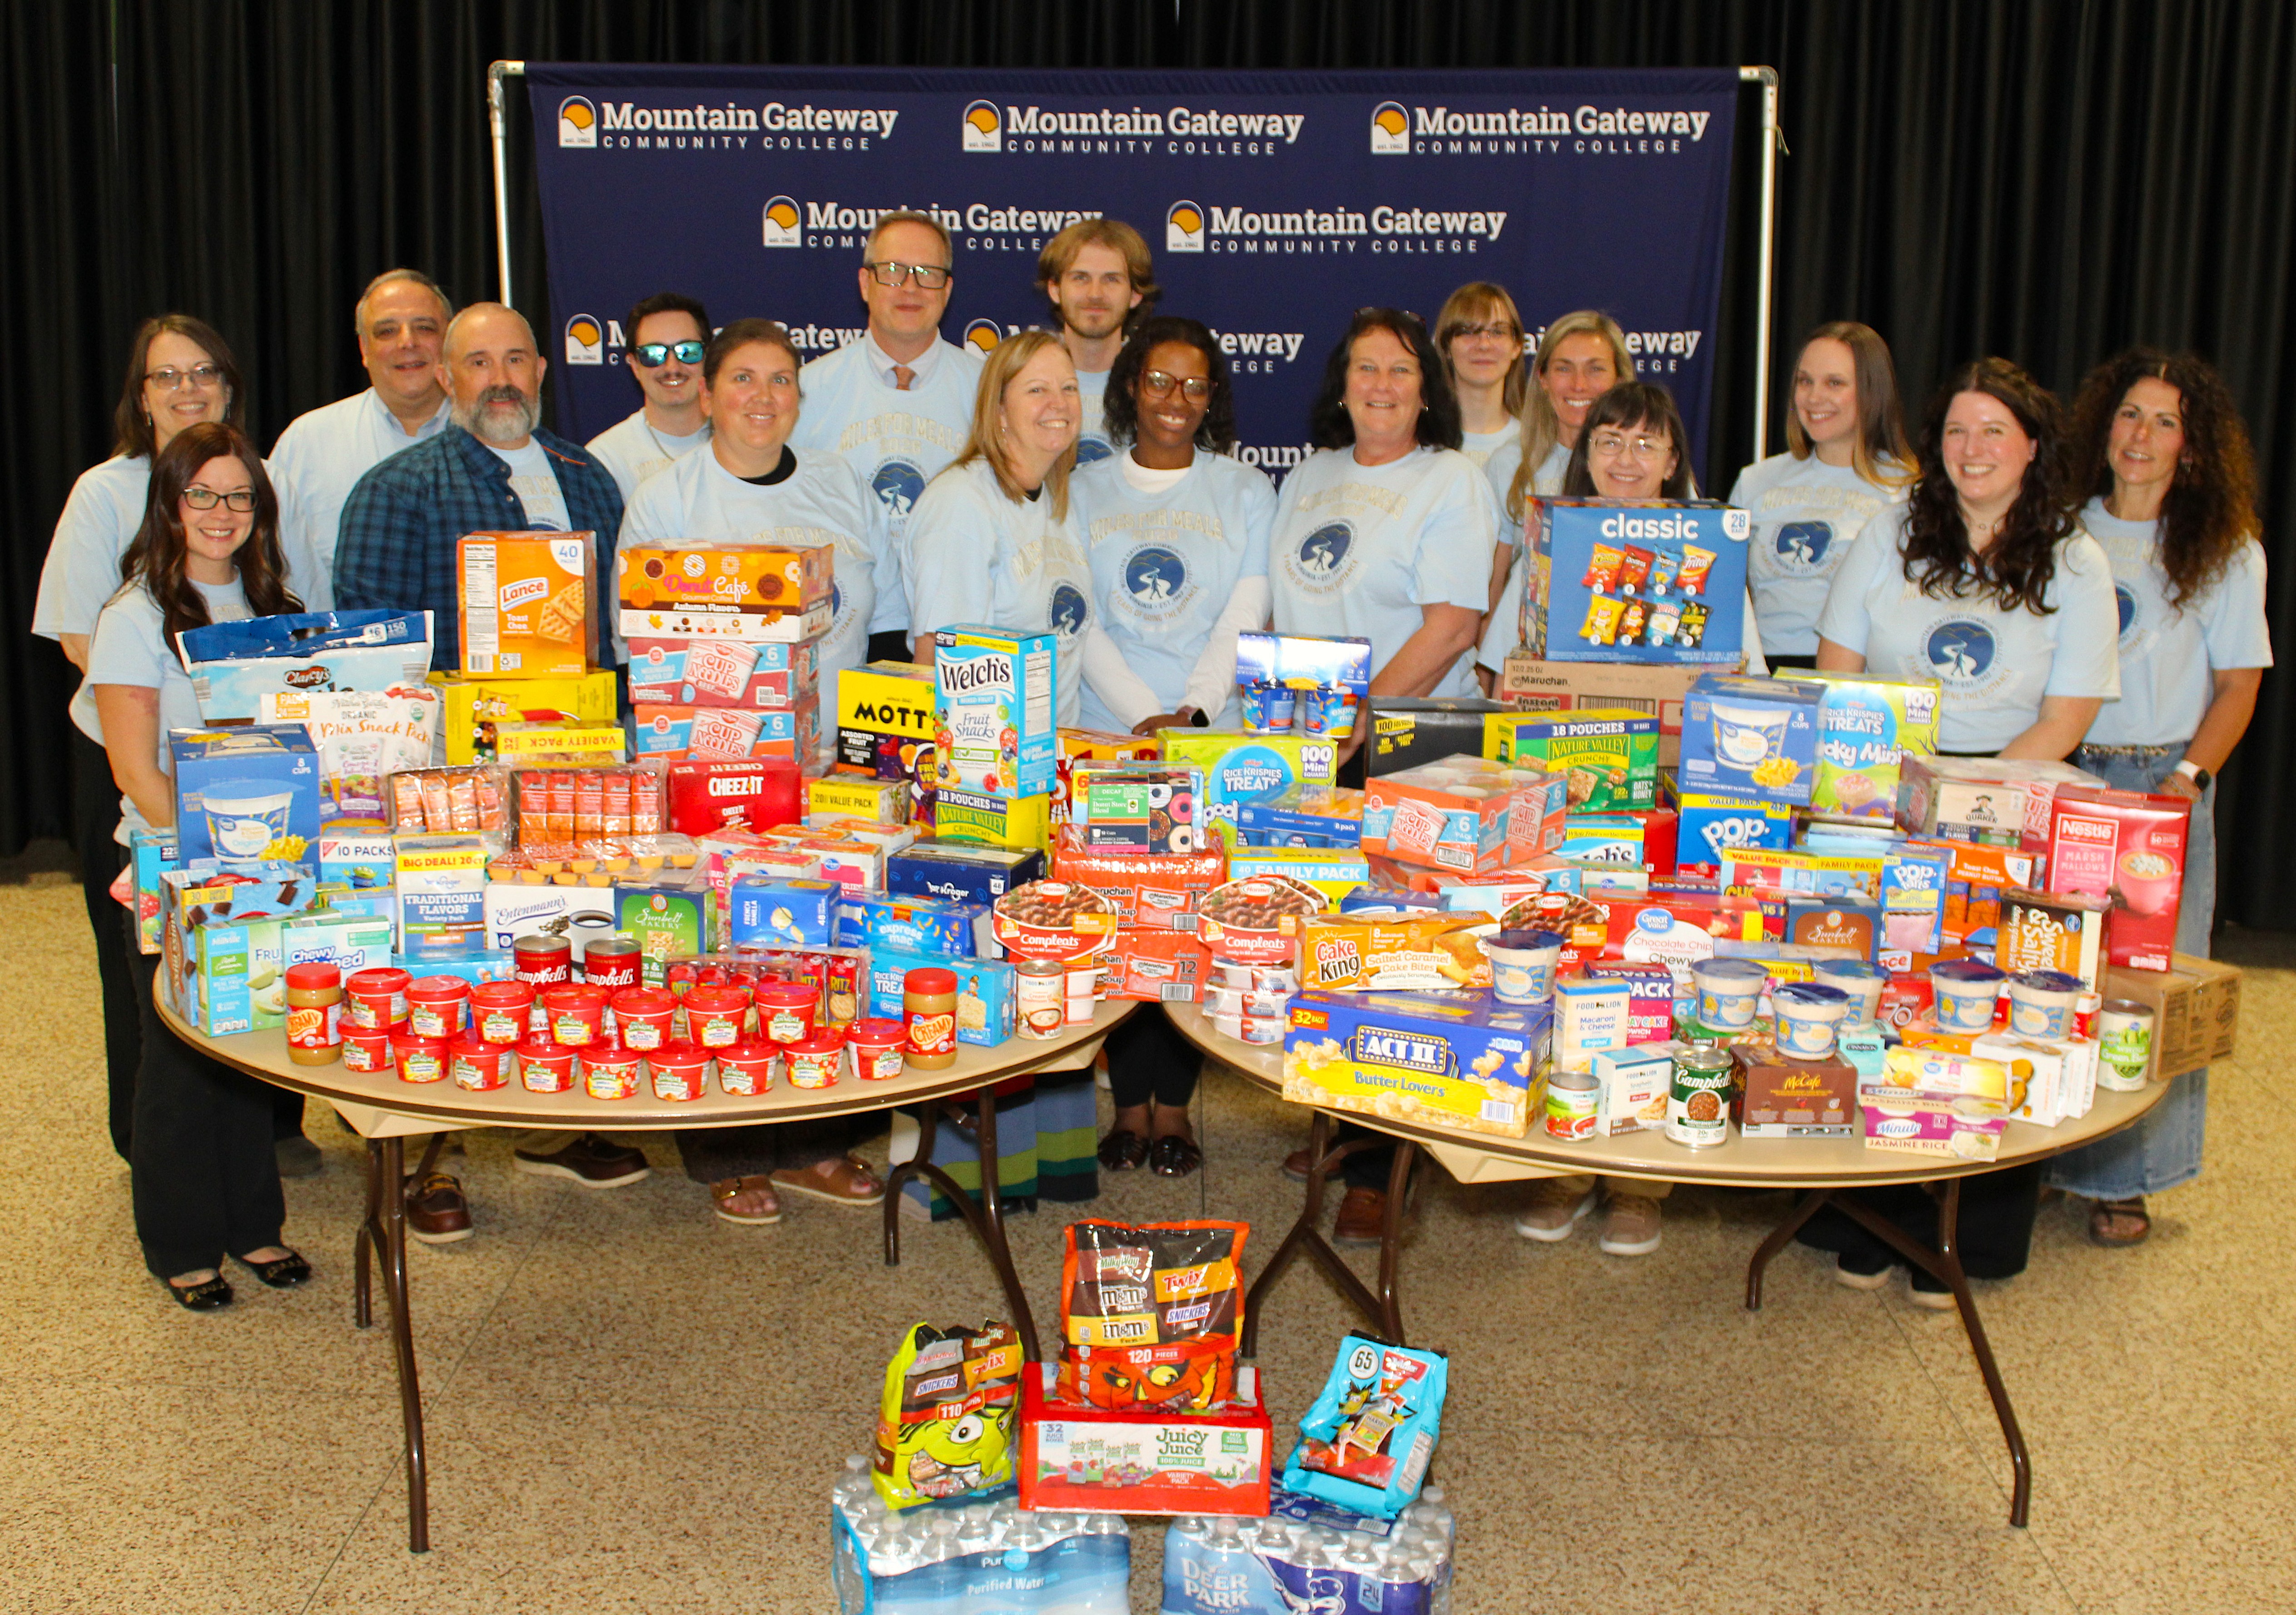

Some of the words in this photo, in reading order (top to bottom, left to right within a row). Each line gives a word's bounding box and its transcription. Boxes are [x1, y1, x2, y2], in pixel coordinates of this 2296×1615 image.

[602, 102, 759, 131] Mountain
[763, 103, 899, 138] Gateway
[1008, 106, 1164, 135] Mountain
[1168, 107, 1304, 142] Gateway
[1415, 107, 1571, 135] Mountain
[1575, 106, 1710, 140] Gateway
[604, 136, 748, 149] COMMUNITY
[764, 137, 870, 150] COLLEGE
[1009, 141, 1152, 154] COMMUNITY
[1169, 142, 1275, 155] COLLEGE
[1416, 140, 1559, 153] COMMUNITY
[1575, 140, 1681, 153] COLLEGE
[1210, 206, 1368, 235] Mountain
[1372, 206, 1506, 241] Gateway
[1211, 240, 1357, 253] COMMUNITY
[1372, 240, 1477, 253] COLLEGE
[1601, 513, 1699, 539] classic
[1731, 514, 1746, 528] 28
[1090, 514, 1134, 550] MILES
[1138, 509, 1167, 528] FOR
[1172, 509, 1223, 541] MEALS
[1132, 529, 1179, 540] 2026
[559, 545, 578, 558] 40
[1683, 555, 1707, 568] Fritos
[502, 580, 544, 602] Lance
[713, 576, 750, 603] Café
[673, 602, 707, 612] Autumn
[708, 603, 741, 613] Flavors
[767, 647, 778, 661] 6
[702, 654, 736, 673] CUP
[687, 662, 740, 691] NOODLES
[941, 658, 1011, 691] Welch's
[1904, 691, 1937, 708] 100
[963, 713, 991, 725] Fruit
[1847, 708, 1885, 721] KRISPIES
[1908, 708, 1931, 718] Mini
[358, 719, 400, 733] Snack
[772, 716, 784, 730] 6
[1553, 725, 1566, 736] 18
[1570, 722, 1625, 734] POUCHES
[1792, 721, 1809, 729] CUPS
[1828, 717, 1883, 735] TREATS
[708, 721, 742, 743] CUP
[840, 730, 875, 741] ASSORTED
[955, 722, 996, 739] Snacks
[848, 738, 867, 746] FRUIT
[1552, 740, 1590, 759] NATURE
[1591, 738, 1626, 755] VALLEY
[1300, 745, 1333, 763] 100
[1567, 754, 1610, 764] CRUNCHY
[292, 767, 312, 775] CUPS
[1223, 768, 1242, 778] RICE
[1243, 767, 1282, 778] KRISPIES
[1303, 762, 1328, 773] Mini
[939, 792, 949, 802] 18
[950, 793, 991, 810] POUCHES
[1633, 789, 1653, 799] HONEY
[830, 795, 852, 806] VALUE
[855, 797, 873, 809] PACK
[1739, 798, 1761, 807] PACK
[1406, 813, 1431, 832] CUP
[1459, 816, 1470, 832] 6
[1966, 814, 1998, 824] QUAKER
[954, 824, 992, 840] CRUNCHY
[1341, 822, 1356, 832] pack
[1394, 818, 1432, 847] NOODLES
[354, 845, 394, 857] PACKS
[2066, 851, 2104, 861] MARSH
[403, 857, 422, 867] BIG
[425, 856, 457, 867] DEAL!
[1732, 852, 1764, 863] VALUE
[1765, 855, 1792, 866] PACK
[1820, 861, 1853, 870] FAMILY
[1855, 861, 1879, 870] PACK
[1319, 866, 1361, 879] PACK
[1963, 863, 1981, 871] Toast
[2061, 863, 2107, 872] MALLOWS
[1957, 870, 1981, 879] PEANUT
[1982, 874, 2005, 883] BUTTER
[939, 882, 969, 902] Kroger
[1241, 884, 1271, 895] Hormel
[404, 893, 482, 904] TRADITIONAL
[419, 904, 469, 915] FLAVORS
[496, 896, 568, 926] Entenmann's
[1642, 914, 1668, 923] Great
[1647, 921, 1668, 930] Value
[879, 924, 924, 941] express
[888, 935, 914, 946] mac
[1021, 935, 1079, 948] Compleats
[1226, 936, 1285, 951] Compleats
[1633, 936, 1686, 947] Chocolate
[1688, 940, 1712, 952] Chip
[291, 946, 335, 961] Chewy
[1317, 940, 1356, 961] Cake
[1368, 955, 1401, 966] Salted
[1405, 953, 1450, 964] Caramel
[1649, 953, 1694, 965] Chewy
[1180, 961, 1197, 973] 12
[1321, 956, 1360, 981] King
[1382, 963, 1408, 972] Cake
[1411, 962, 1435, 971] Bites
[830, 975, 850, 993] RITZ
[1576, 1002, 1595, 1010] FOOD
[1294, 1011, 1312, 1025] 32
[1580, 1016, 1616, 1024] Macaroni
[1884, 1003, 1913, 1026] 70
[1642, 1017, 1669, 1027] CAKE
[913, 1017, 954, 1042] CREAMY
[1367, 1036, 1406, 1060] ACT
[1410, 1042, 1437, 1064] II
[1354, 1070, 1397, 1091] Butter
[1401, 1079, 1446, 1098] Lovers
[1876, 1123, 1922, 1135] Minute
[1870, 1139, 1918, 1148] JASMINE
[1923, 1142, 1948, 1150] RICE
[1163, 1272, 1203, 1292] Twix
[1102, 1287, 1147, 1306] m&m's
[1168, 1305, 1208, 1322] SNICKERS
[1103, 1320, 1149, 1338] m&m's
[1128, 1349, 1152, 1363] 120
[1355, 1350, 1373, 1369] 65
[918, 1376, 957, 1395] SNICKERS
[941, 1405, 962, 1418] 110
[1045, 1424, 1064, 1433] 32
[1156, 1428, 1209, 1445] Juicy
[1159, 1442, 1204, 1456] Juice
[1182, 1557, 1249, 1590] DEER
[968, 1576, 1012, 1596] Purified
[1014, 1577, 1045, 1590] Water
[1184, 1578, 1250, 1608] PARK
